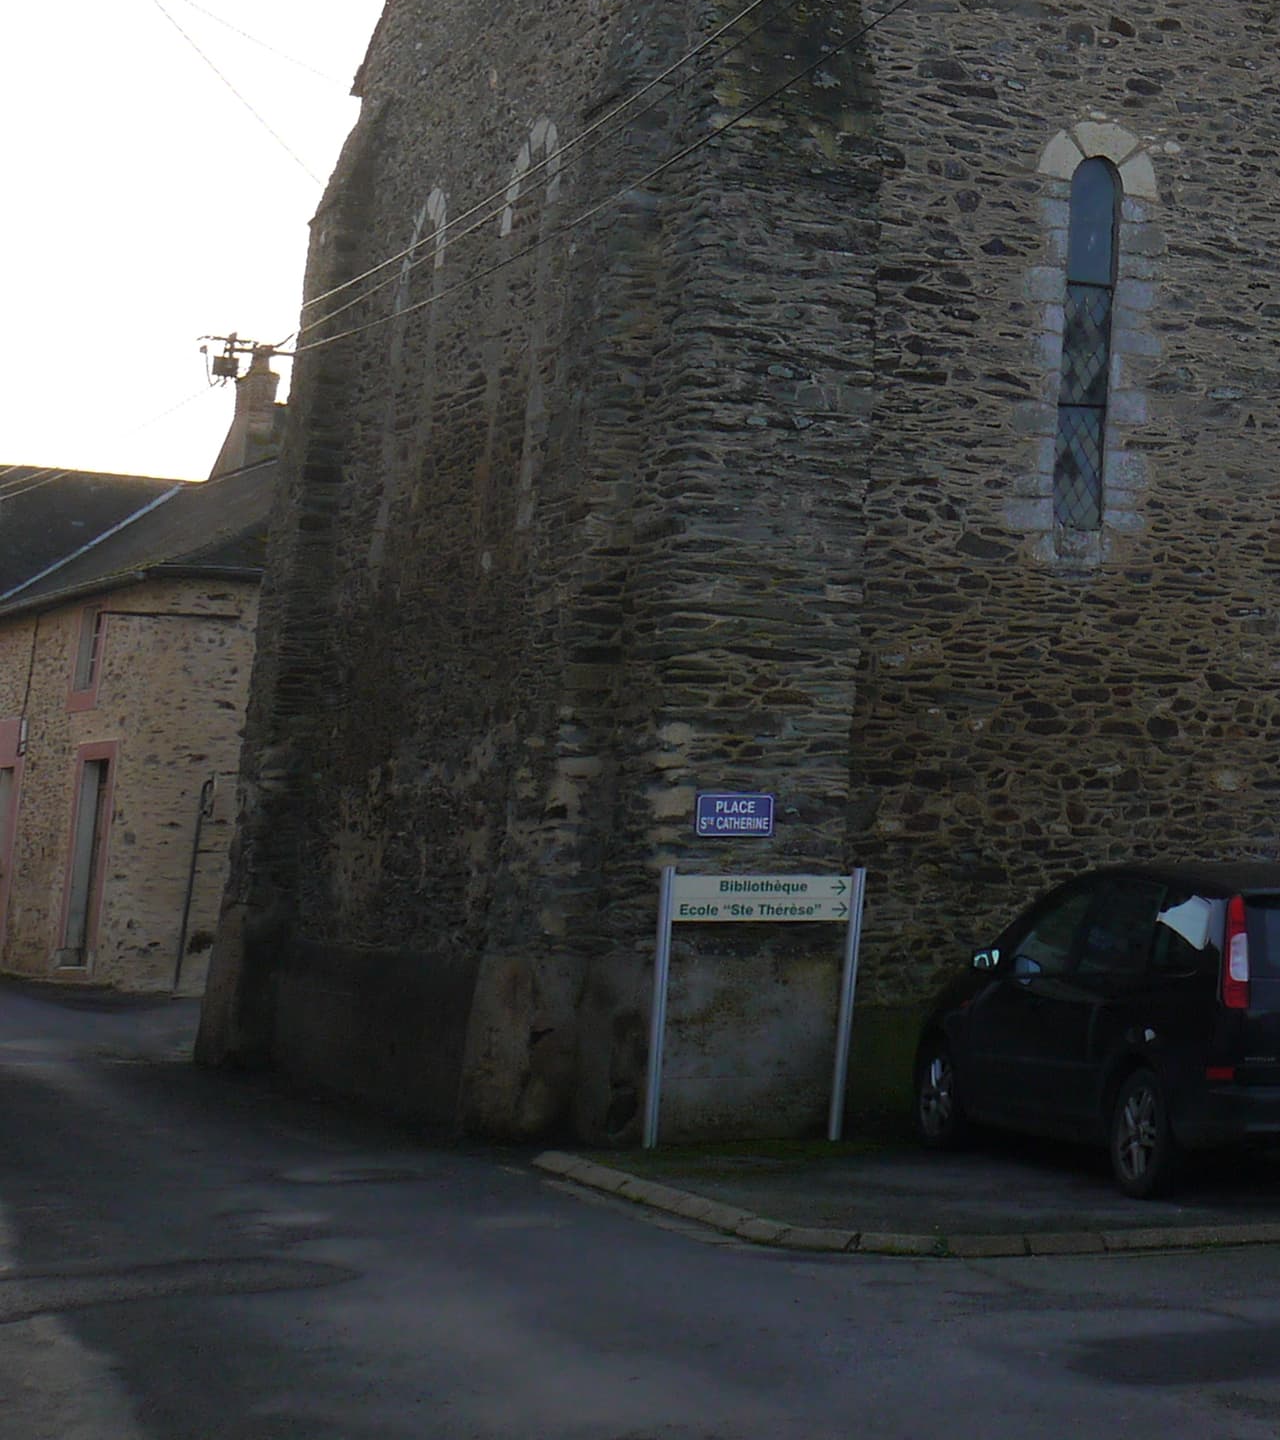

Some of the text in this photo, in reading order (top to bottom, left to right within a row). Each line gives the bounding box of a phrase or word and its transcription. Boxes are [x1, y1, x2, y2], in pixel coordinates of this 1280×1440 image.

[715, 800, 757, 814] PLACE
[716, 817, 769, 831] CATHERINE
[719, 880, 808, 895] Bibliothèque
[679, 903, 719, 916] Ecole
